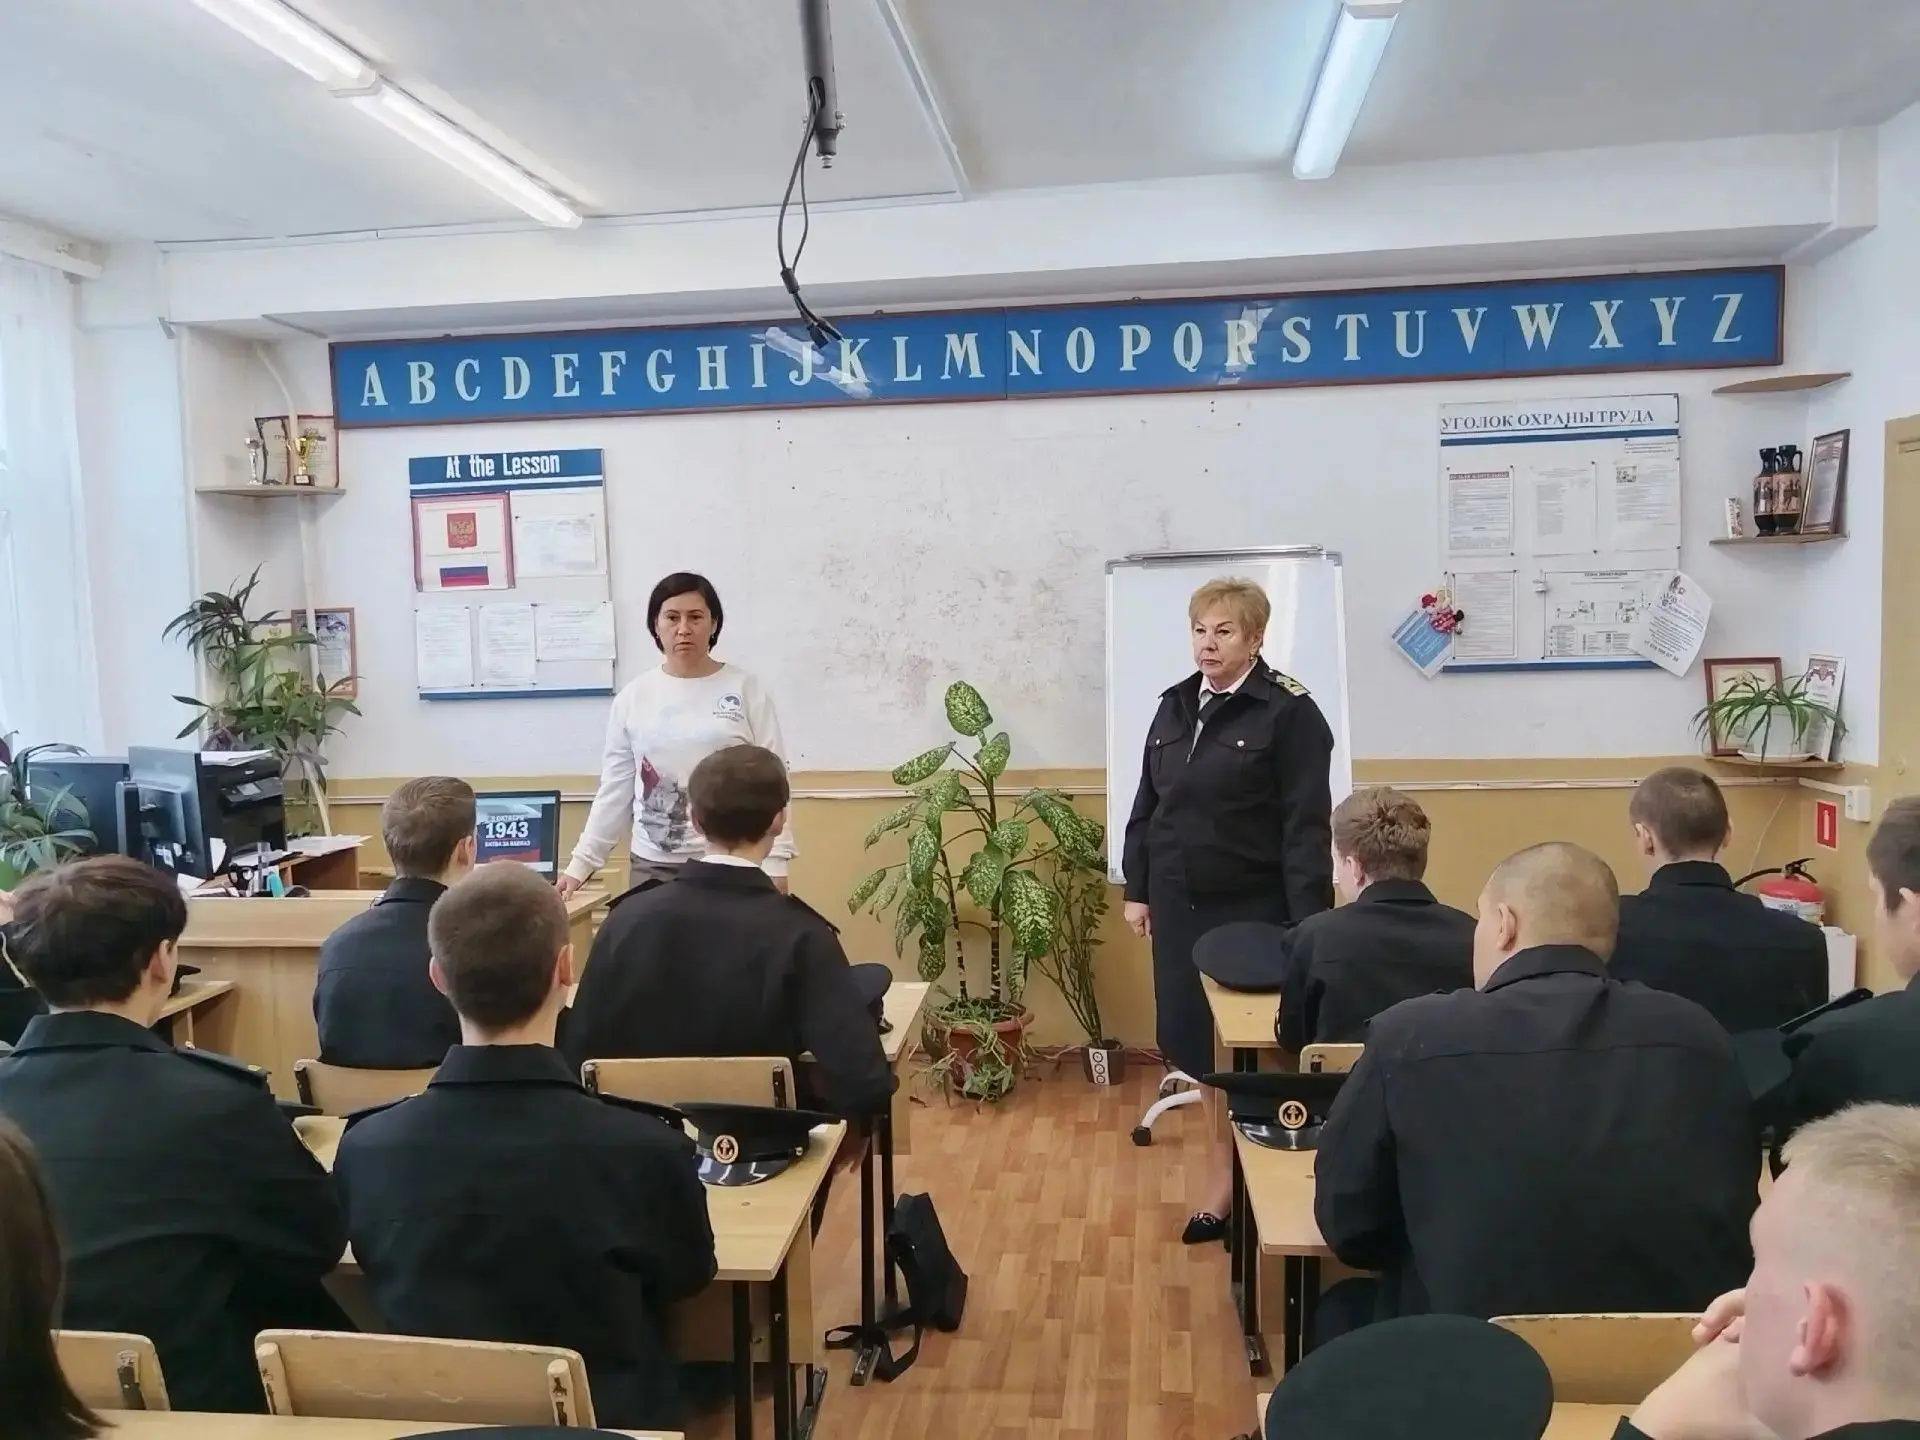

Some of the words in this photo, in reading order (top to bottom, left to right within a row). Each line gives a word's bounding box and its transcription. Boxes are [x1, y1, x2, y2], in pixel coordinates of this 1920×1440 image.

[361, 362, 388, 406] A
[408, 361, 436, 404] B
[455, 358, 481, 401] C
[502, 356, 531, 400] D
[551, 353, 580, 398] E
[599, 351, 626, 395] F
[646, 349, 676, 393] G
[696, 345, 730, 391] H
[750, 343, 767, 388] I
[892, 336, 922, 382] L
[940, 332, 985, 380] M
[1008, 329, 1043, 376] N
[1066, 326, 1095, 373] O
[1119, 324, 1151, 371] P
[1173, 322, 1203, 373] Q
[1282, 316, 1311, 363] S
[1336, 314, 1369, 361] T
[1393, 311, 1426, 358] U
[1453, 307, 1485, 352] V
[1511, 303, 1564, 350] W
[1589, 300, 1623, 349] X
[1652, 297, 1680, 346] Y
[1713, 293, 1744, 343] Z
[1441, 415, 1514, 431] УГОЛОК
[1518, 411, 1594, 426] ОХРАНЫ
[1594, 410, 1654, 423] ТРУДА
[446, 455, 461, 479] At
[469, 454, 495, 478] the
[502, 453, 560, 476] Lesson
[486, 821, 528, 838] 1943
